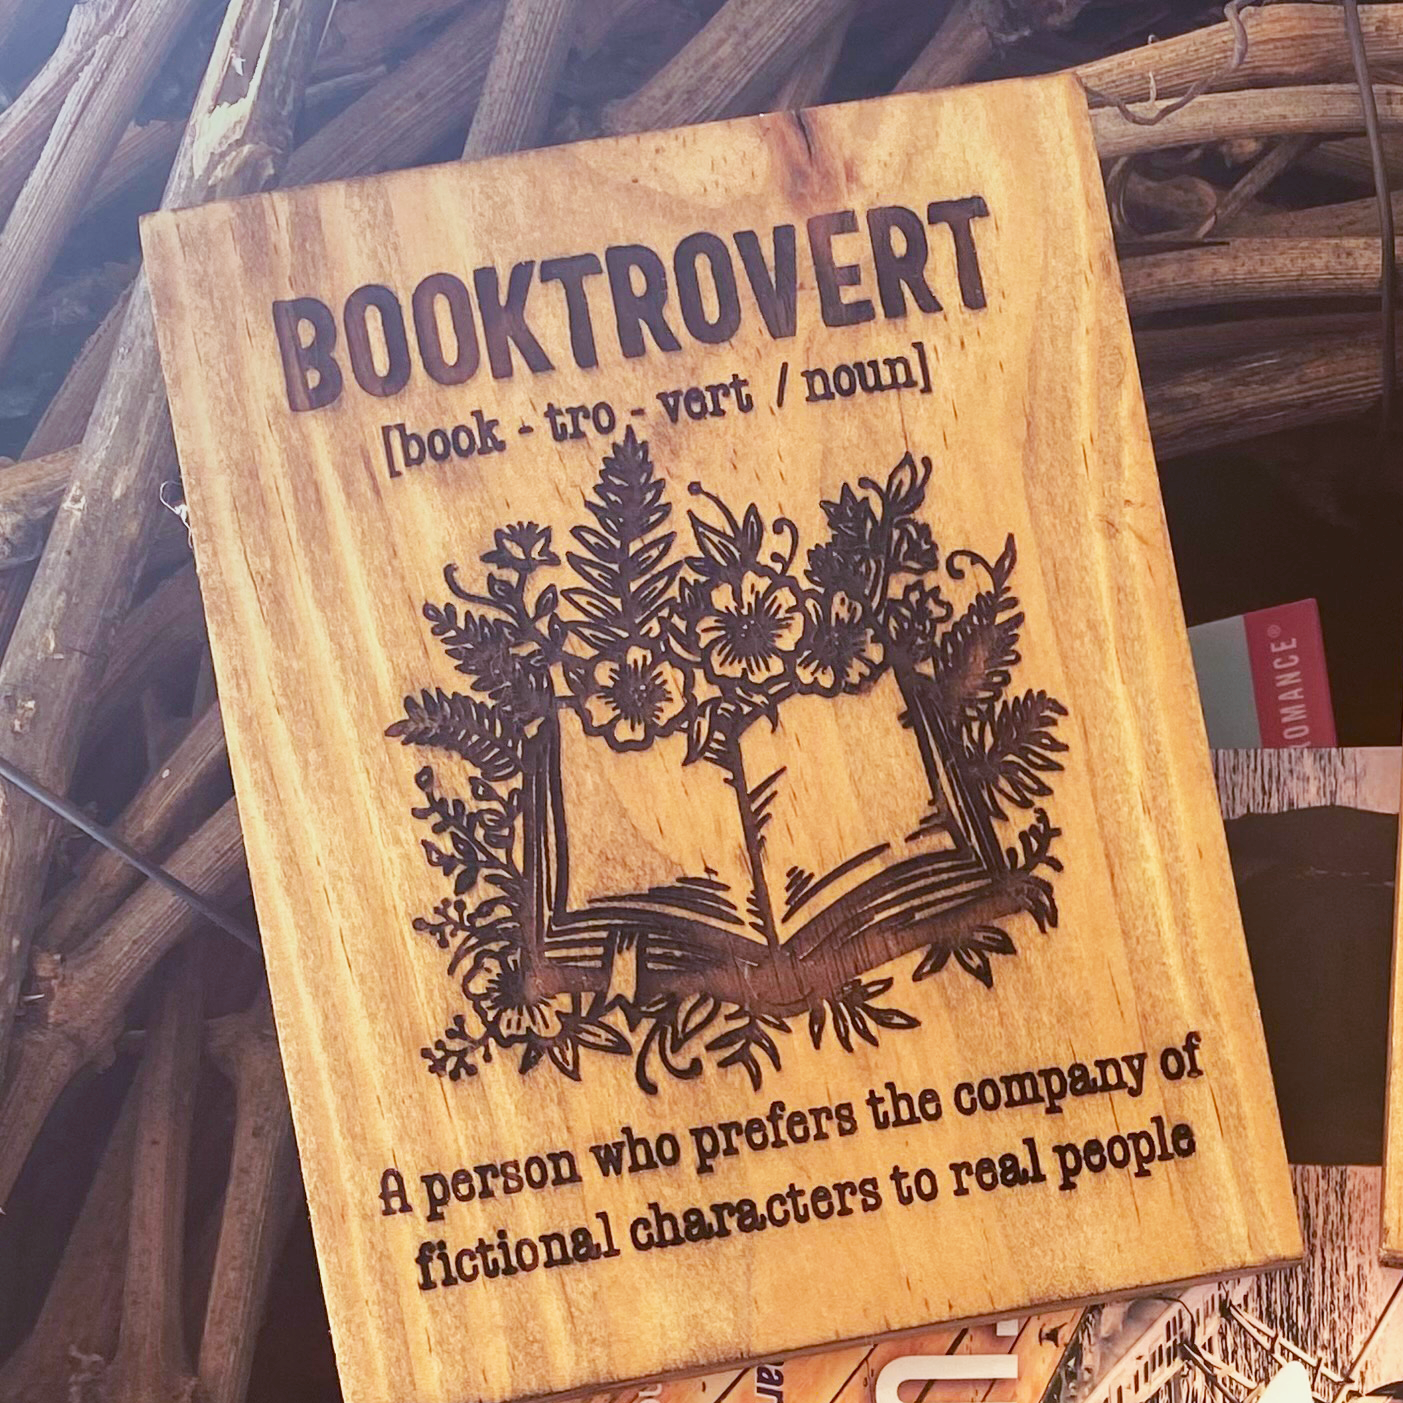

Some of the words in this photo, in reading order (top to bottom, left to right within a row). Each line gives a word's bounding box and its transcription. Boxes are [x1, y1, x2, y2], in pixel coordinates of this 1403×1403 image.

[272, 195, 989, 411] BOOKTROVERT
[381, 409, 507, 477] [book
[544, 400, 616, 442] tro
[657, 373, 753, 425] vert
[803, 342, 932, 403] noun]
[377, 1168, 413, 1215] A
[422, 1150, 582, 1225] person
[590, 1125, 681, 1178] who
[689, 1094, 857, 1176] prefers
[867, 1081, 943, 1131] the
[953, 1055, 1146, 1116] company
[1159, 1032, 1205, 1078] of
[415, 1211, 621, 1290] fictional
[630, 1175, 882, 1253] characters
[889, 1163, 936, 1203] to
[951, 1138, 1046, 1197] real
[1056, 1115, 1197, 1192] people
